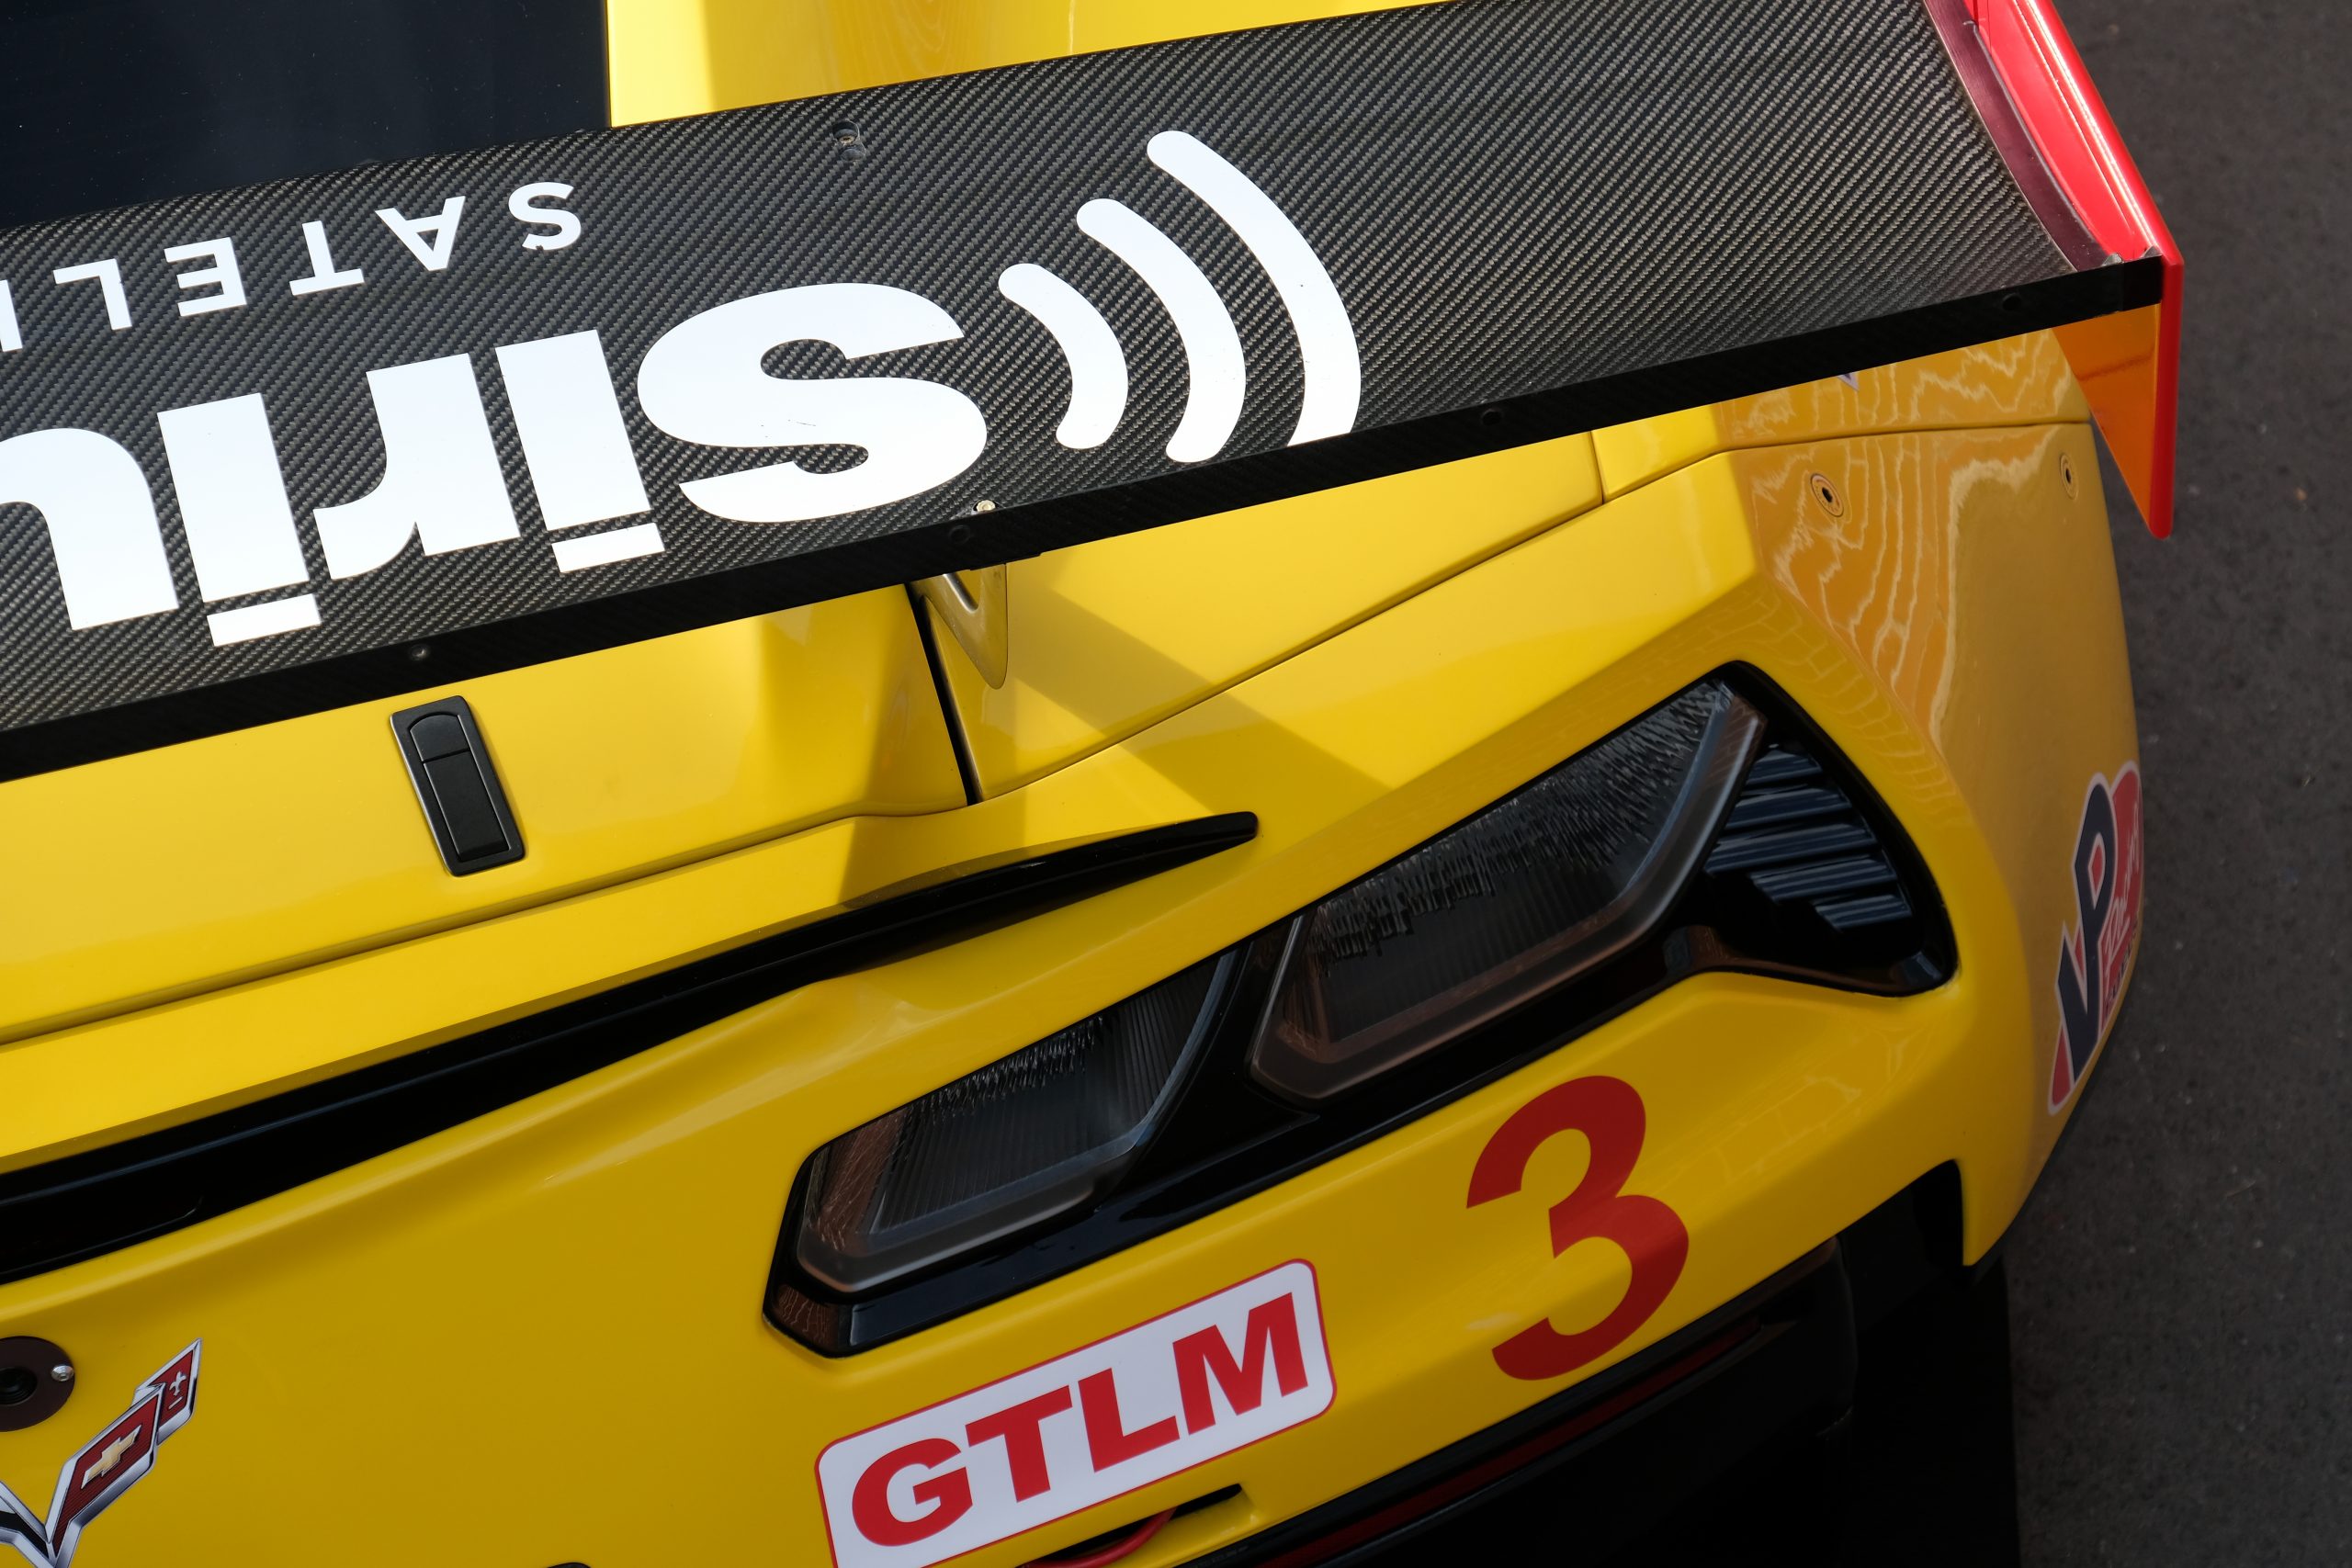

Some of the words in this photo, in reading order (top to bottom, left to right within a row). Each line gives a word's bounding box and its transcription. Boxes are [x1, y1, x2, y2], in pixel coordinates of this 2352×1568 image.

[0, 182, 582, 352] SATEL
[2055, 774, 2117, 1087] VP
[1466, 1075, 1689, 1380] 3
[852, 1292, 1308, 1547] GTLM
